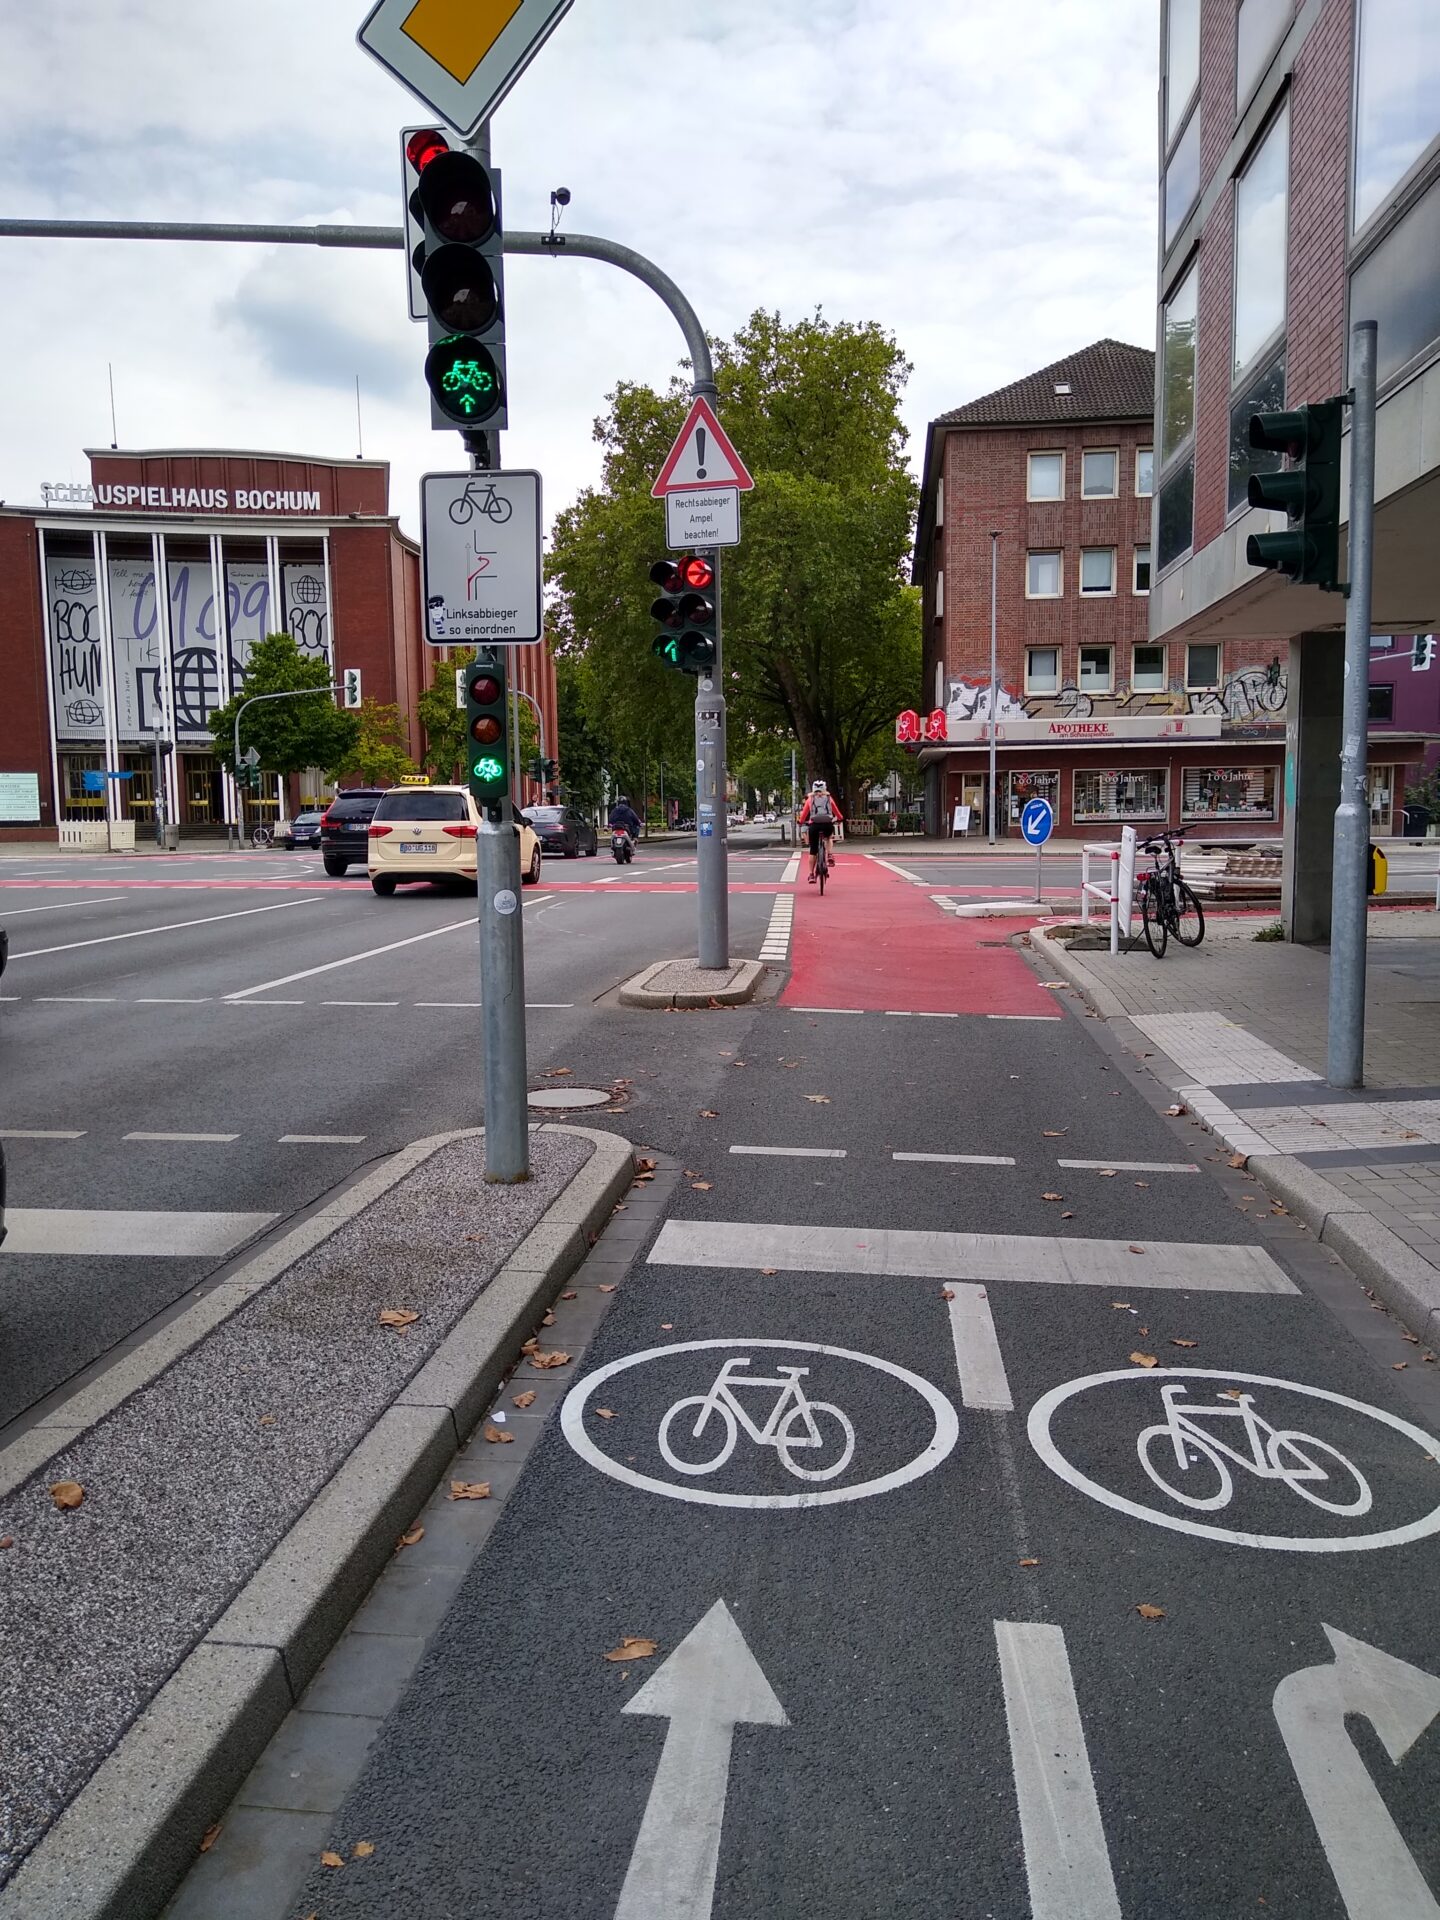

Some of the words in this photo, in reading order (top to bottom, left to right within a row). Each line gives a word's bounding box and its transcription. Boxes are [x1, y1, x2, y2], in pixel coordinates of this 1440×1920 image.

[40, 482, 227, 508] SCHAUSPIELHAUS
[236, 490, 320, 510] BOCHUM
[675, 497, 730, 508] Rechtsabbieger
[690, 513, 713, 523] Ampel
[685, 528, 719, 539] beachten!
[446, 608, 518, 620] Linksabbieger
[465, 624, 516, 634] einordnen
[1033, 774, 1057, 786] Jahre
[1120, 772, 1144, 784] Jahre
